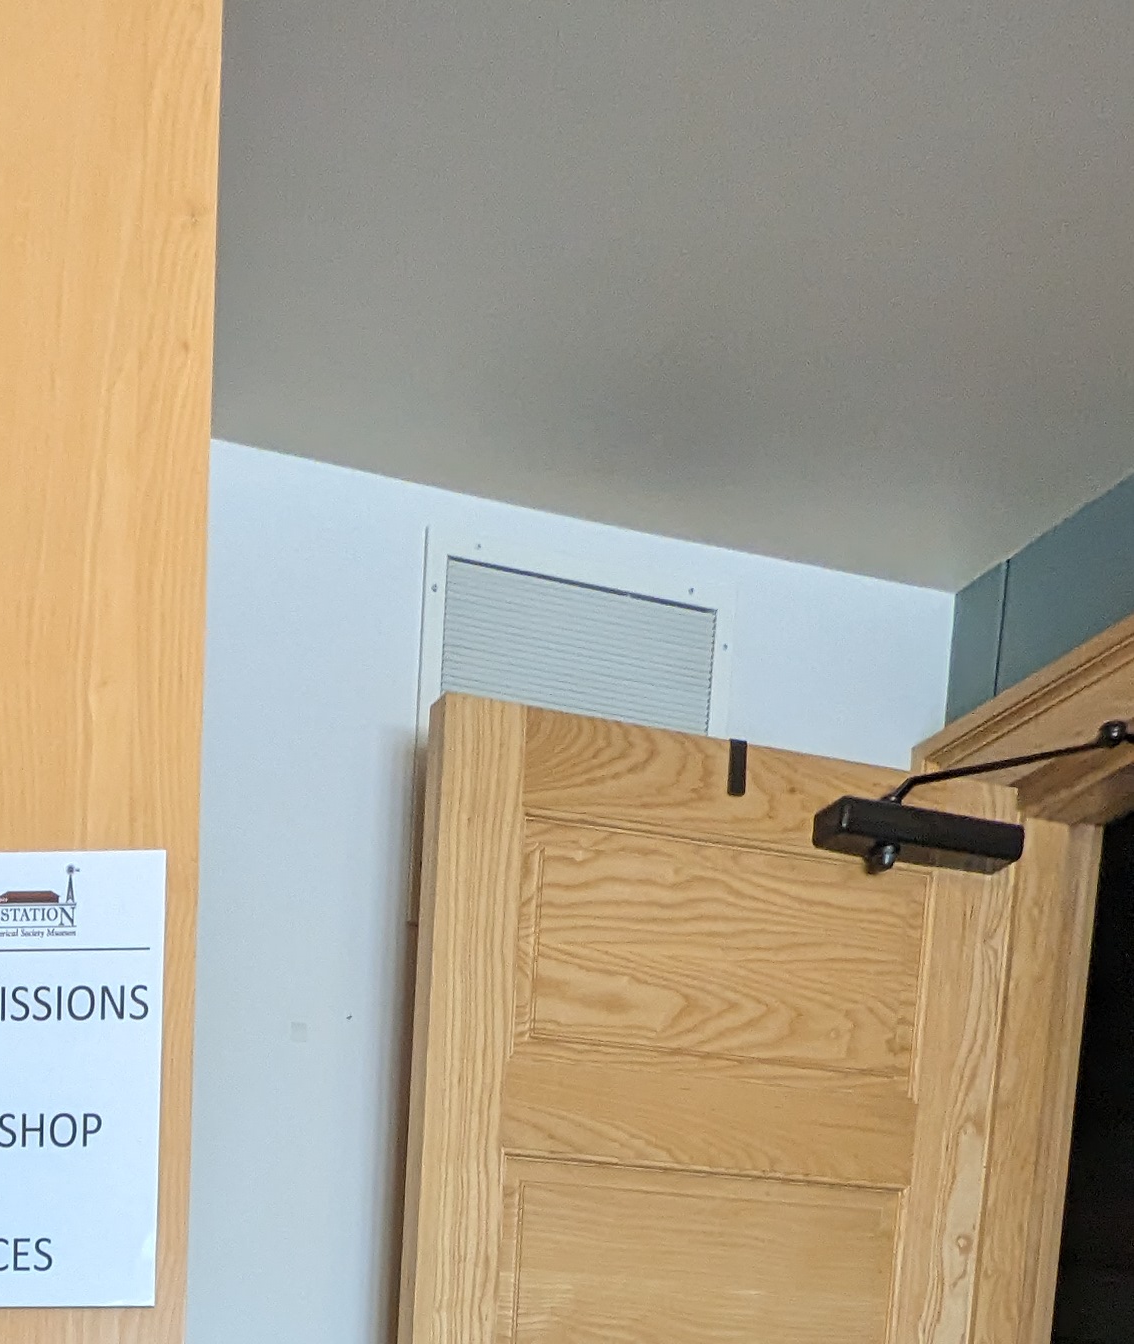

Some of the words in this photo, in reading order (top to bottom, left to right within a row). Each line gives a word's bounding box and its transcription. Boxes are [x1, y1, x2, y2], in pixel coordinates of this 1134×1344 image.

[0, 906, 76, 927] STATION
[20, 928, 45, 939] Society
[46, 928, 77, 937] Museum
